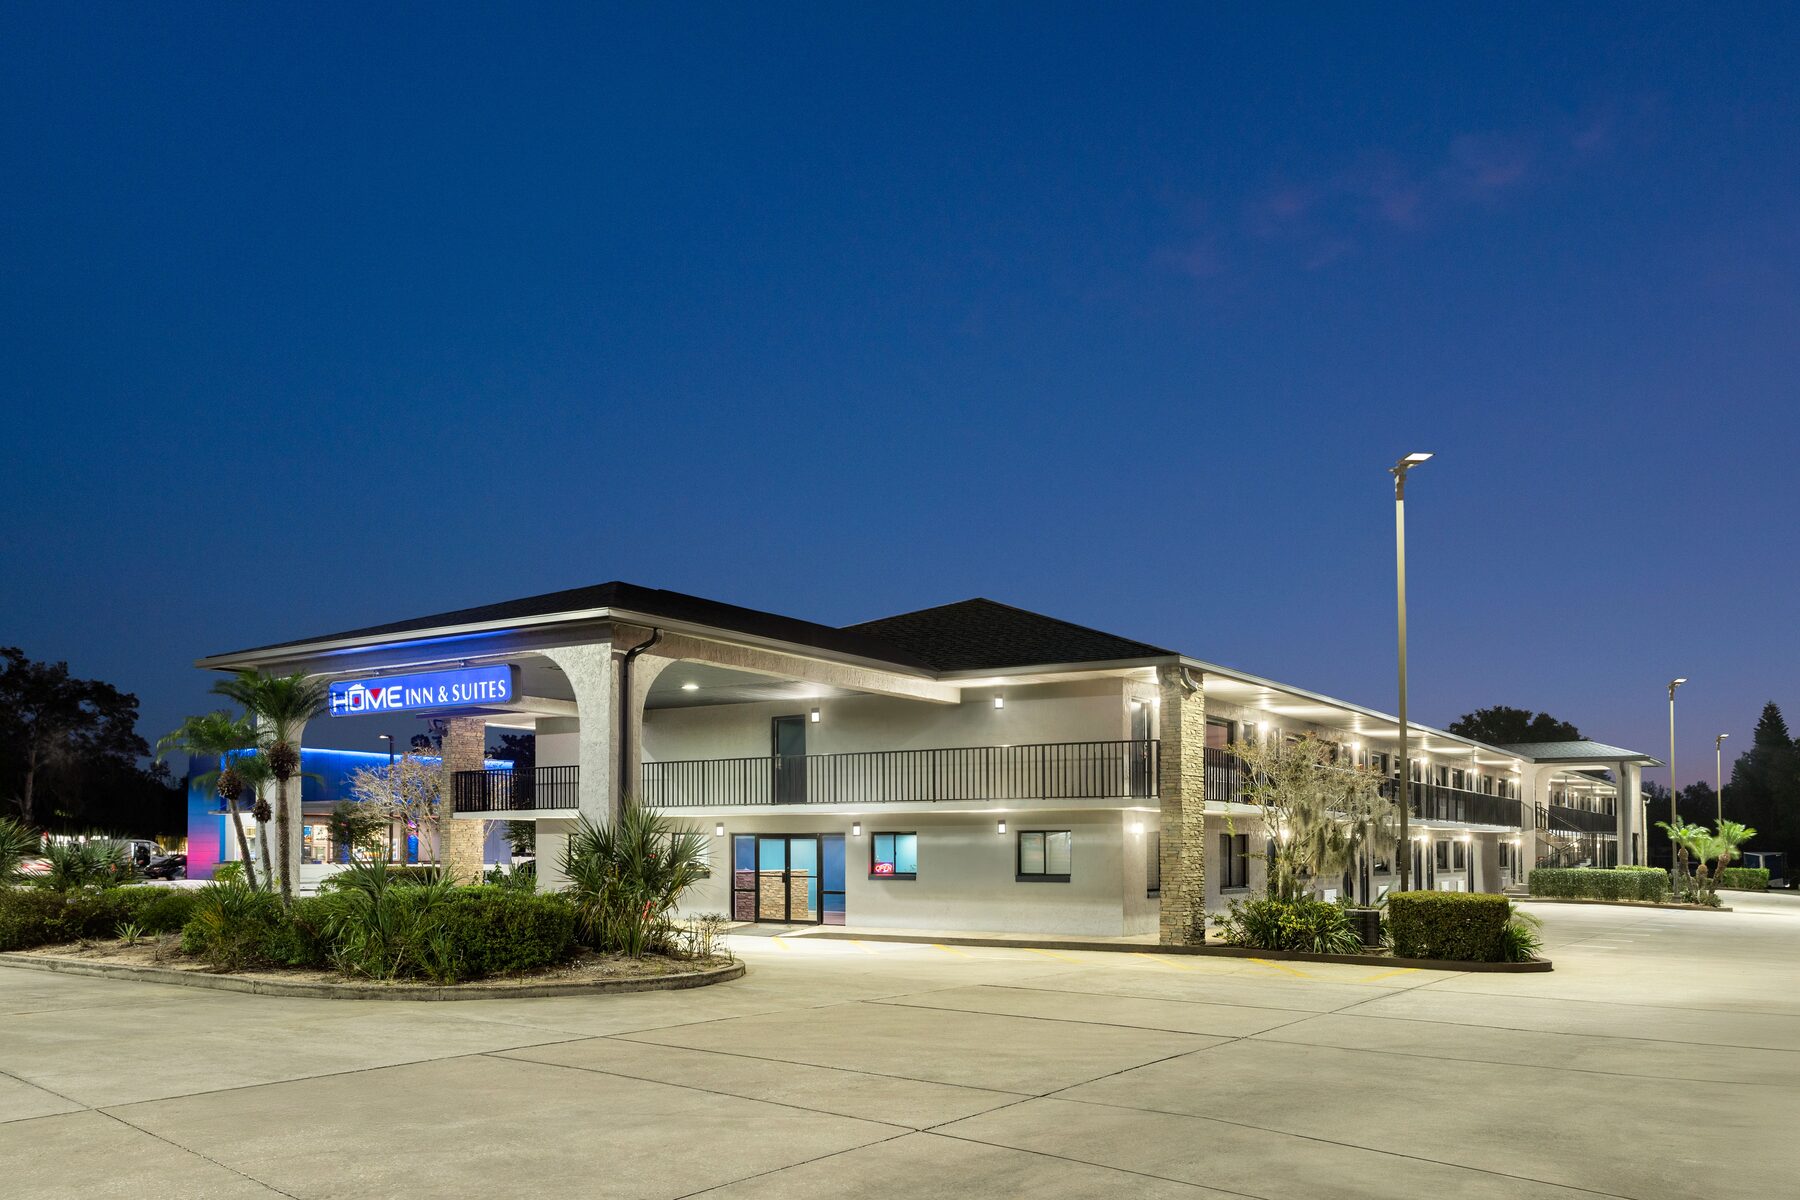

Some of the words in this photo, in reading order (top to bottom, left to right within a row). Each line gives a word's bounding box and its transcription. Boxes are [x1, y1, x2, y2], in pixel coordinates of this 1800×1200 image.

[332, 684, 403, 712] HOME
[405, 687, 434, 706] INN
[438, 685, 449, 703] &
[452, 679, 507, 702] SUITES
[875, 863, 893, 873] OPEN
